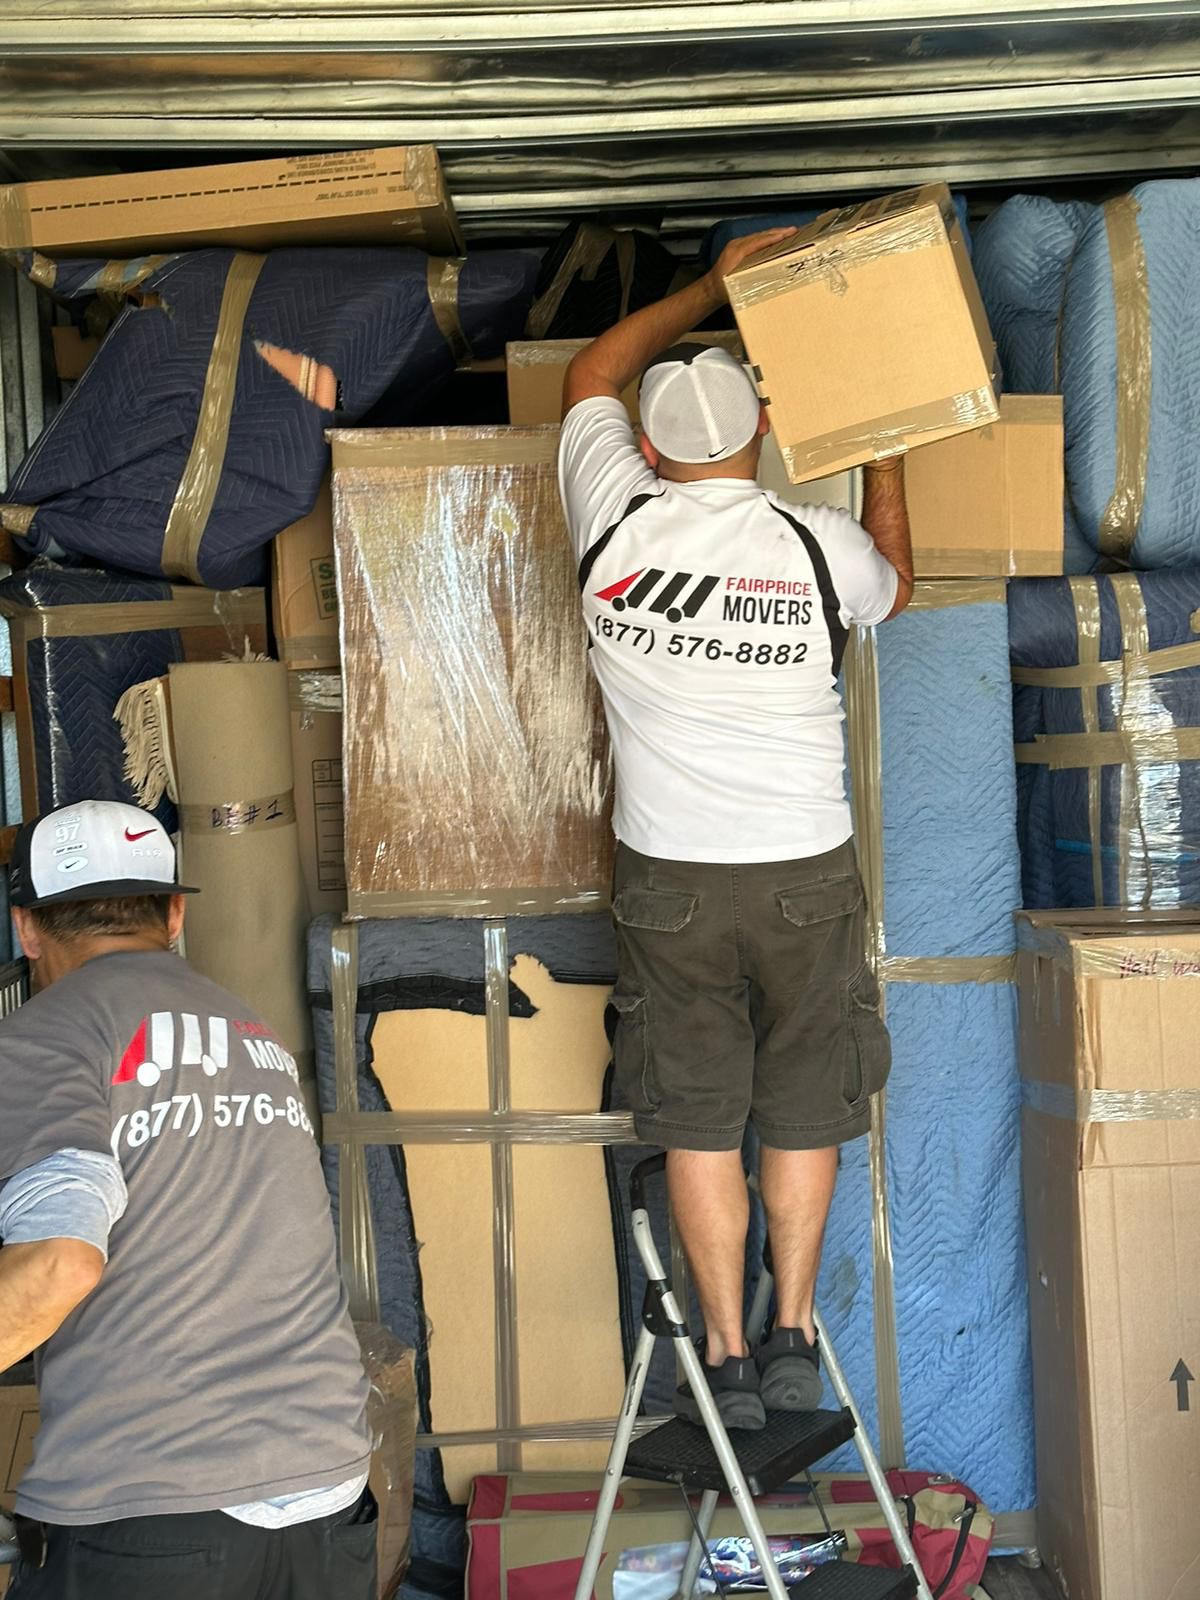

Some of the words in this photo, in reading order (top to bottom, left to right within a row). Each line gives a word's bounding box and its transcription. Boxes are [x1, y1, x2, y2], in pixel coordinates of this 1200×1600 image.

[726, 576, 812, 596] FAIRPRICE
[722, 595, 813, 626] MOVERS
[594, 614, 656, 655] (877)
[667, 633, 808, 665] 576-8882
[55, 823, 80, 843] 97
[110, 1092, 203, 1162] (877)
[214, 1092, 315, 1138] 576-88
